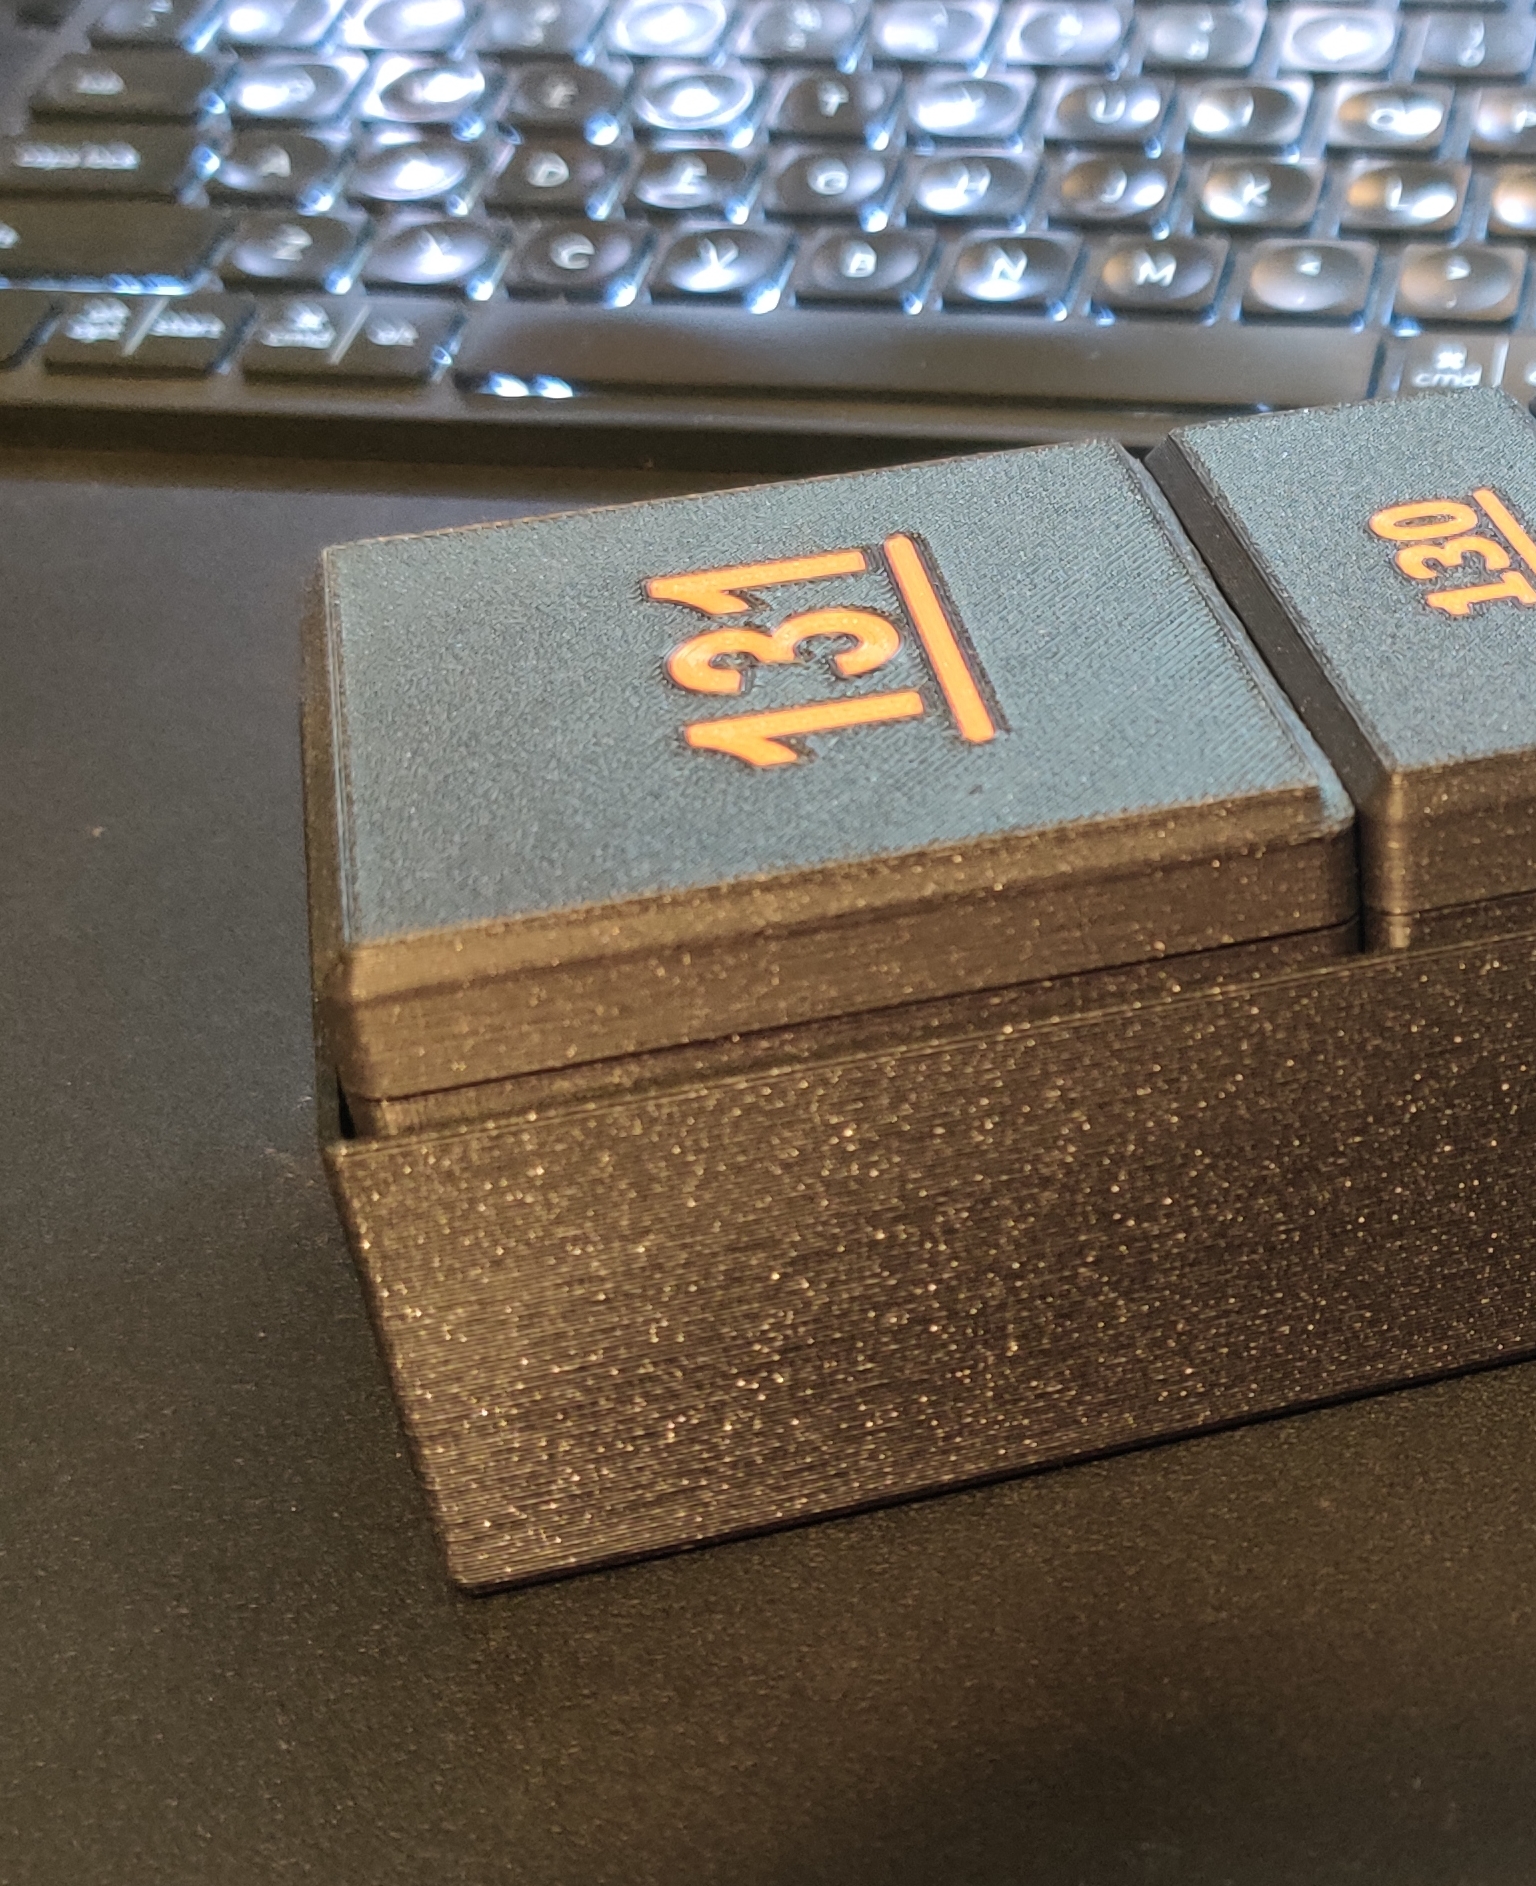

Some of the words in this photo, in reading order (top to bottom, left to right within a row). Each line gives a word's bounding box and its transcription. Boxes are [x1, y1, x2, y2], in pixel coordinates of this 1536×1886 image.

[989, 247, 1028, 282] N
[1134, 250, 1178, 287] M
[647, 550, 925, 768] 131
